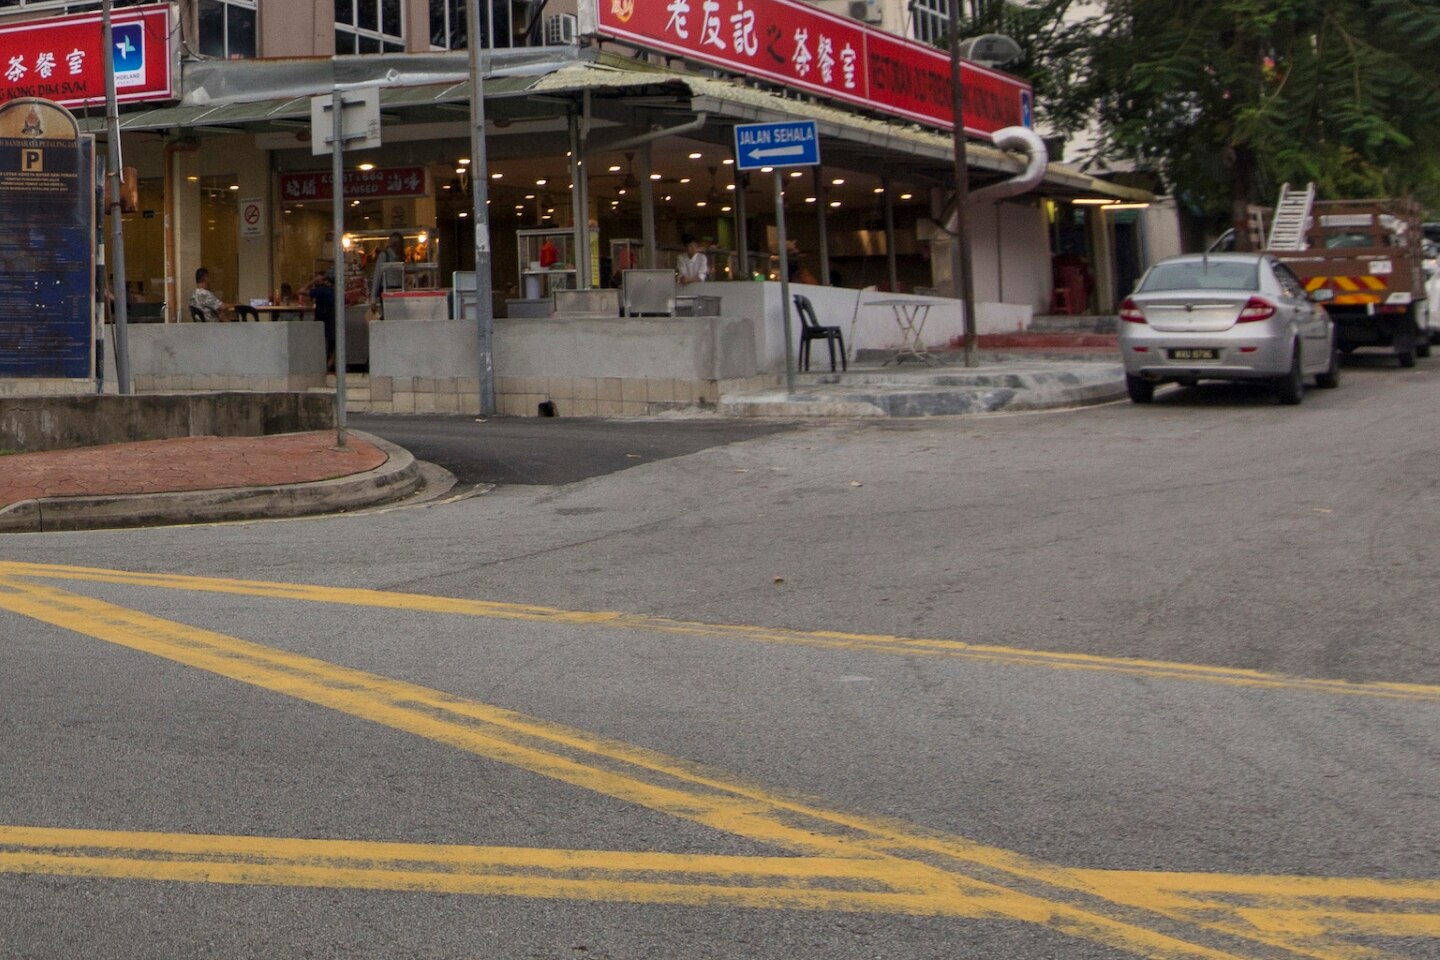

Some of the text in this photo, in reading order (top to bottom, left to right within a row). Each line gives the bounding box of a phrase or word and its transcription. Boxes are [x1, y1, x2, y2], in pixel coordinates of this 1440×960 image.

[38, 83, 60, 97] DIM
[739, 126, 814, 145] JALAN SEHALA
[26, 150, 40, 169] P
